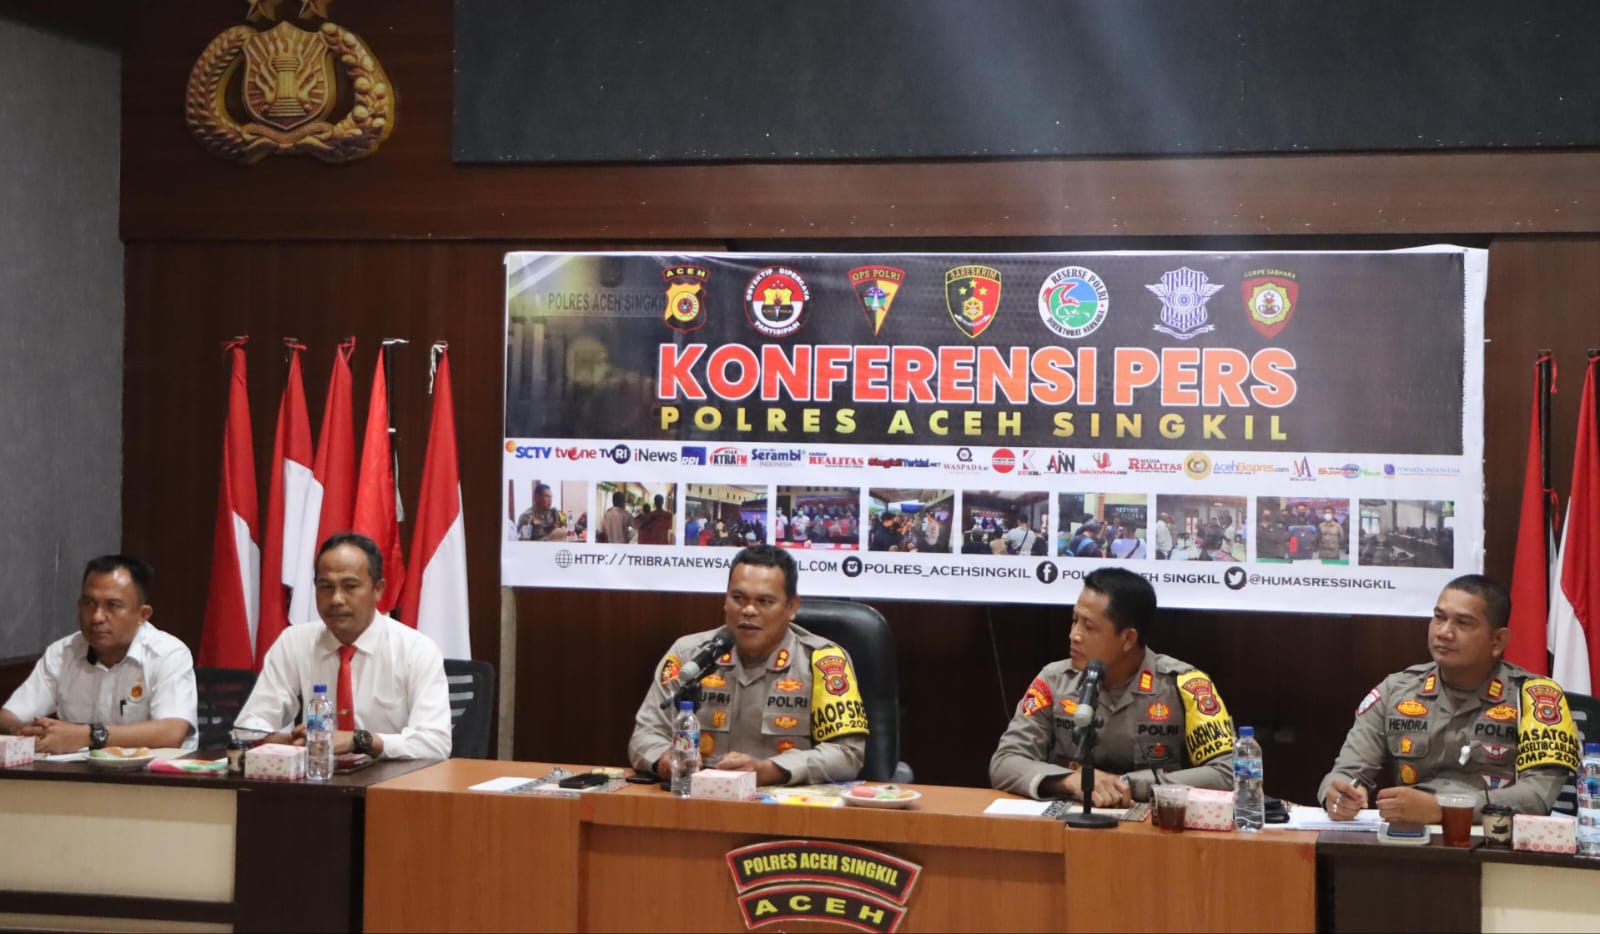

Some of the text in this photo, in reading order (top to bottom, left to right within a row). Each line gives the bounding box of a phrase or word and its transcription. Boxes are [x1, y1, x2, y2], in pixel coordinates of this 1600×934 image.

[666, 268, 706, 278] ACEH
[853, 269, 900, 281] OPS POLRI
[1051, 268, 1108, 301] RESERSE POLRI
[592, 293, 620, 311] ACEH
[755, 320, 800, 335] PARTISIPASI
[658, 343, 1298, 407] KONFERENSI PERS
[660, 406, 1288, 440] POLRES ACEH SINGKIL
[515, 445, 552, 459] SCTV
[634, 447, 677, 462] iNews
[751, 448, 802, 461] Serambi
[808, 457, 864, 465] REALITAS
[864, 563, 1031, 579] POLRES_ACEHSINGKIL
[1163, 573, 1220, 584] SINGKIL
[1250, 573, 1396, 589] @HUMASRESSINGKIL
[767, 696, 808, 709] POLRI
[1138, 725, 1178, 737] POLRI
[1389, 717, 1428, 731] HENDRA
[743, 852, 898, 887] POLRES ACEH SINGKIL
[754, 895, 885, 925] ACEH
